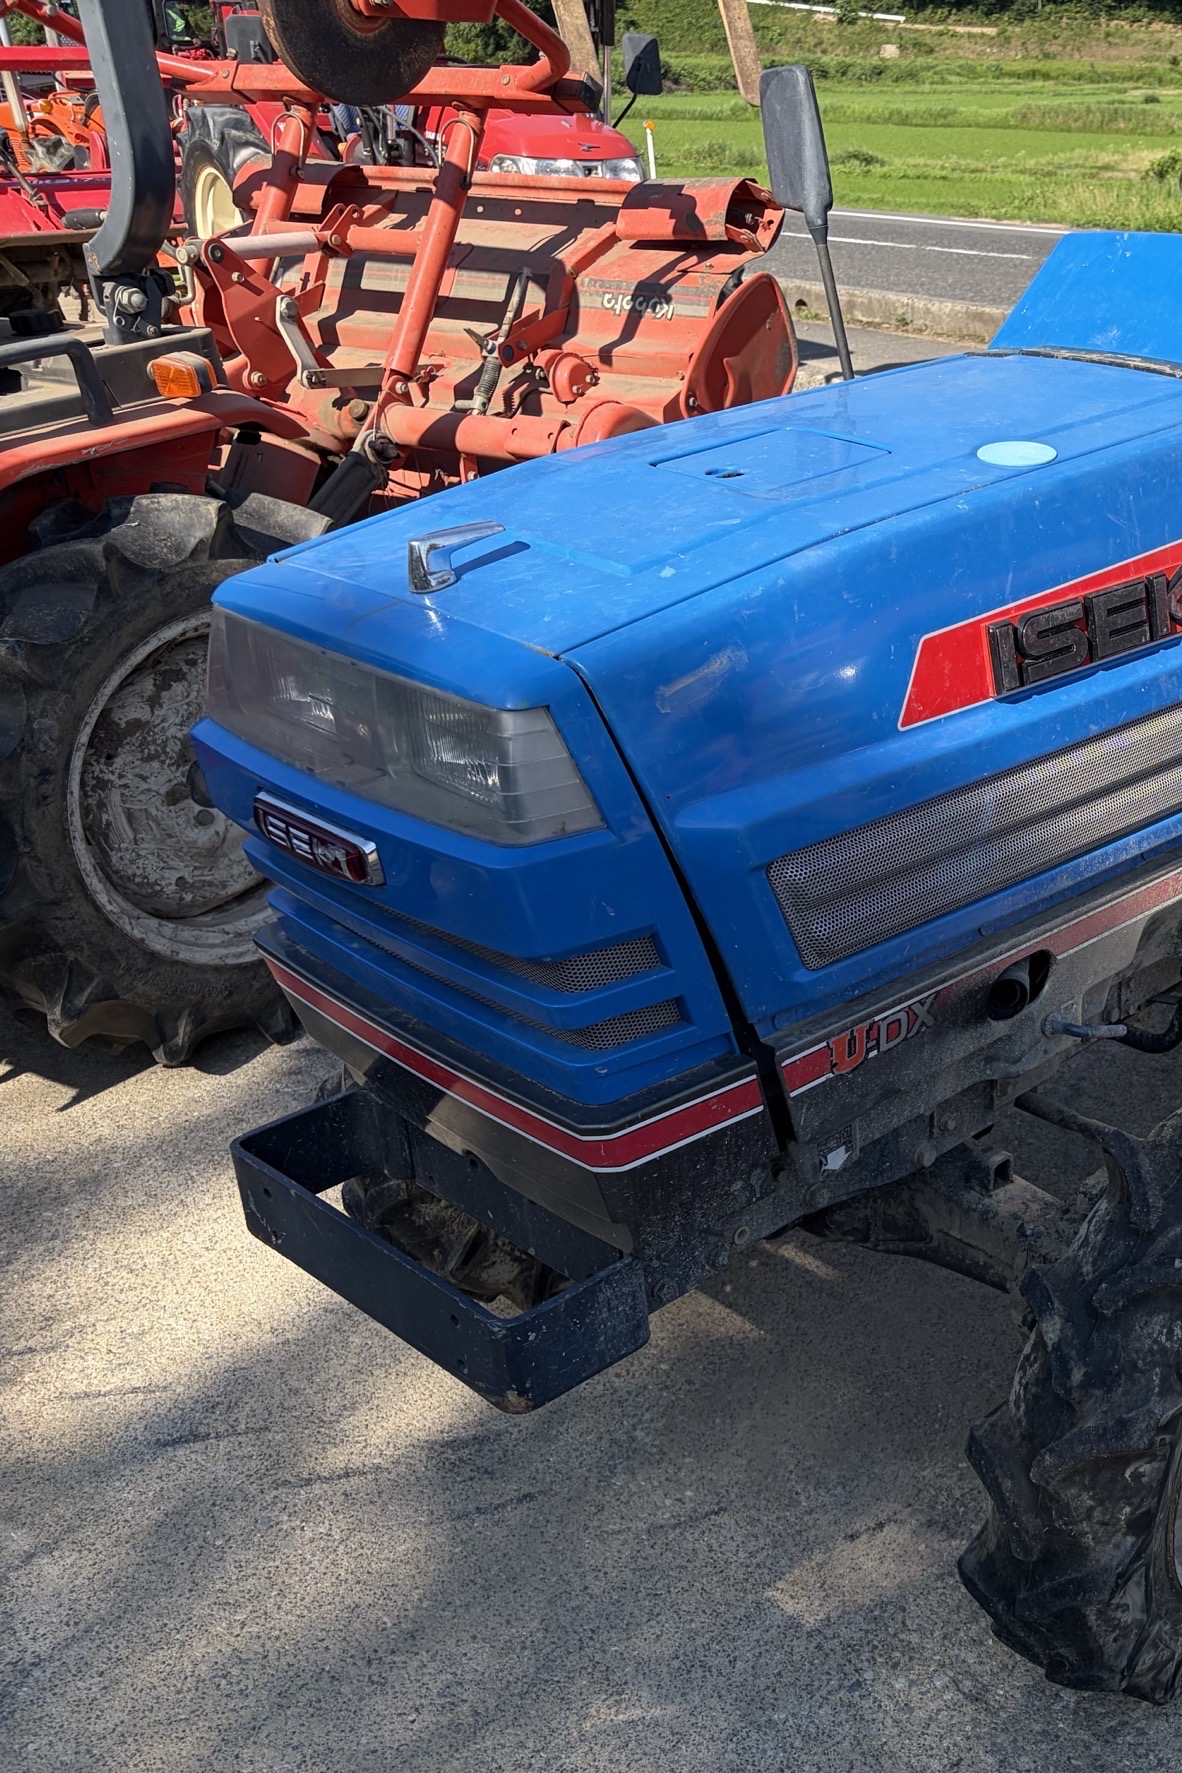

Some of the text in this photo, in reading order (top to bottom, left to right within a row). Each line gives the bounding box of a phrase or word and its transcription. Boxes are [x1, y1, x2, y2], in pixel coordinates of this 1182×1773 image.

[602, 292, 675, 321] Kubota
[257, 808, 355, 881] ISEKI
[828, 993, 938, 1076] U-DX
